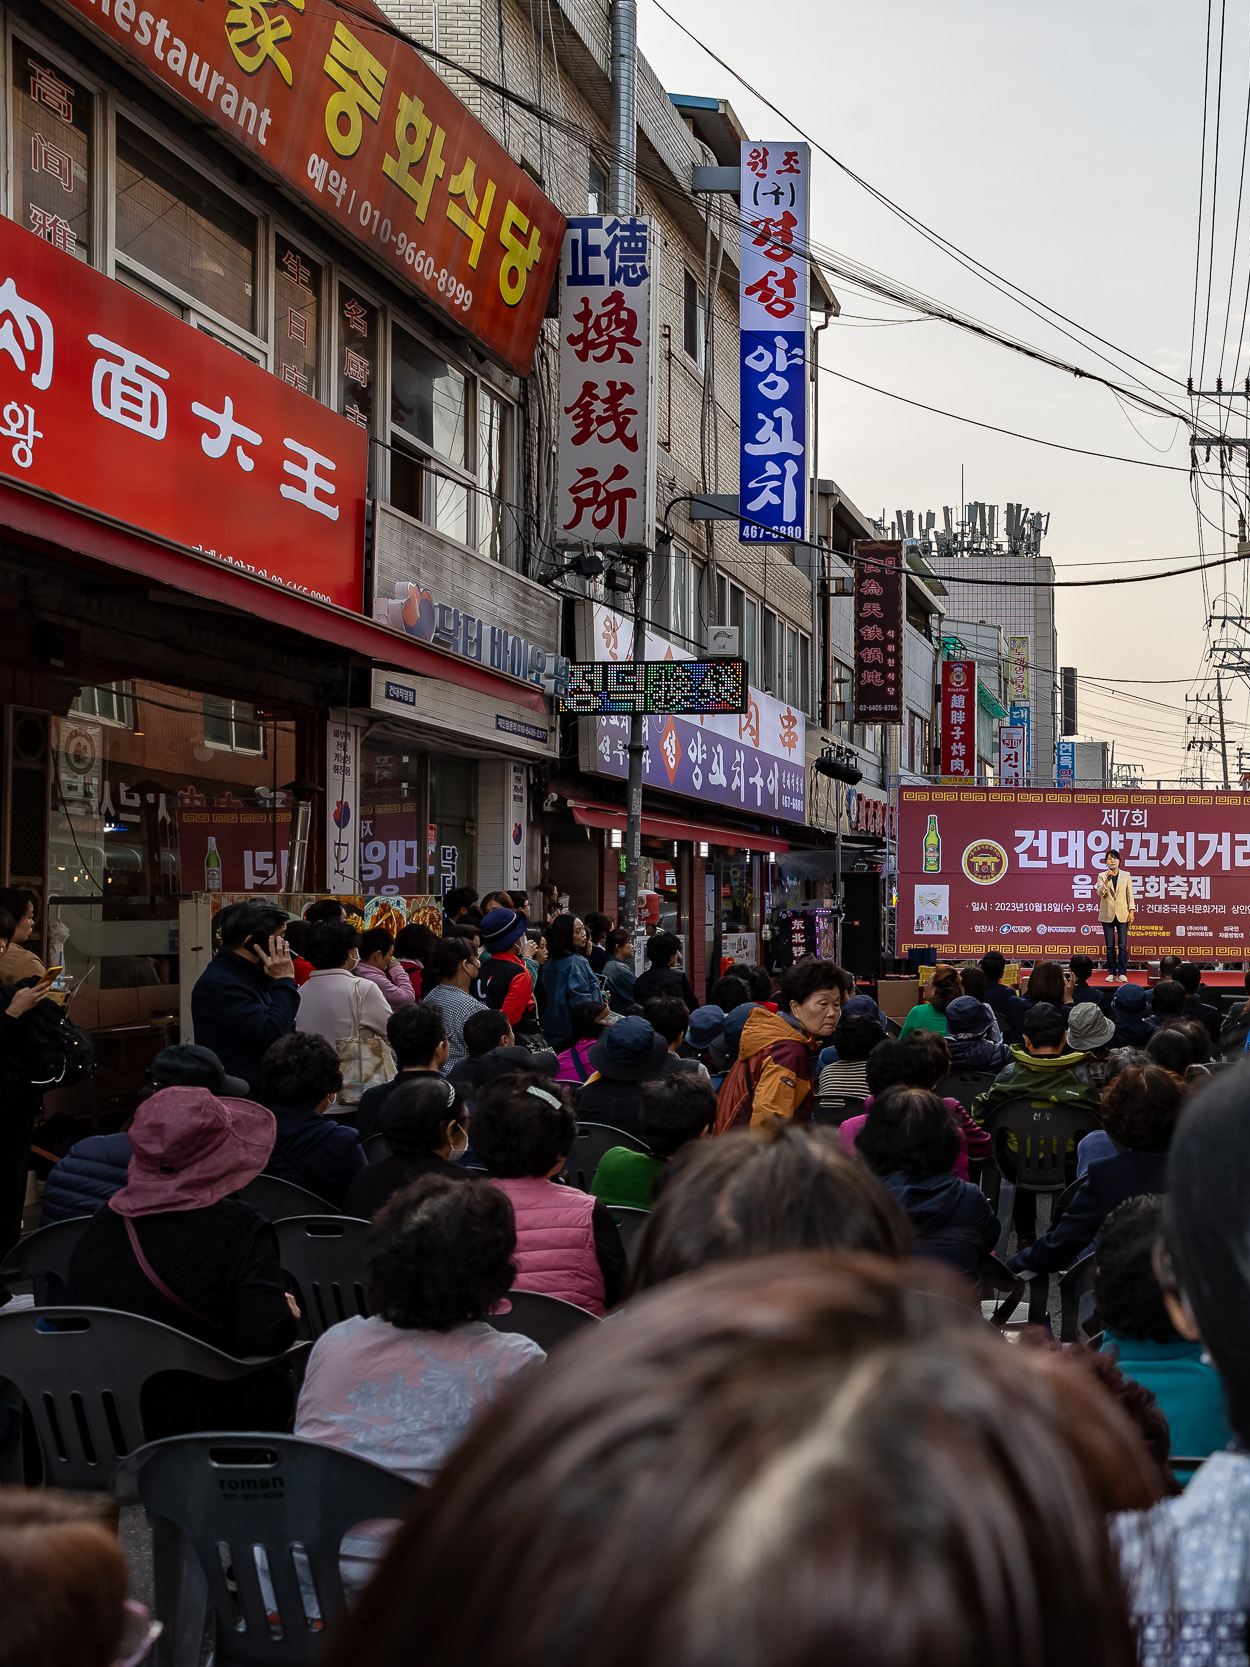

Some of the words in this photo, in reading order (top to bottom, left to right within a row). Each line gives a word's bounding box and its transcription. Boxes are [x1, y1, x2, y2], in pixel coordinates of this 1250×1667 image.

[323, 20, 542, 307] 중화식당
[747, 147, 802, 179] 원조
[307, 152, 349, 209] 예약
[358, 200, 474, 313] 010-9660-8999
[565, 215, 649, 289] 正德
[745, 210, 799, 319] 경성
[745, 335, 804, 523] 양꼬치
[743, 524, 803, 541] 467-6880
[688, 730, 780, 810] 양꼬치구이
[1101, 808, 1149, 828] 제7회
[1146, 904, 1226, 915] 건대중국음식문화거리
[218, 1476, 284, 1491] roman
